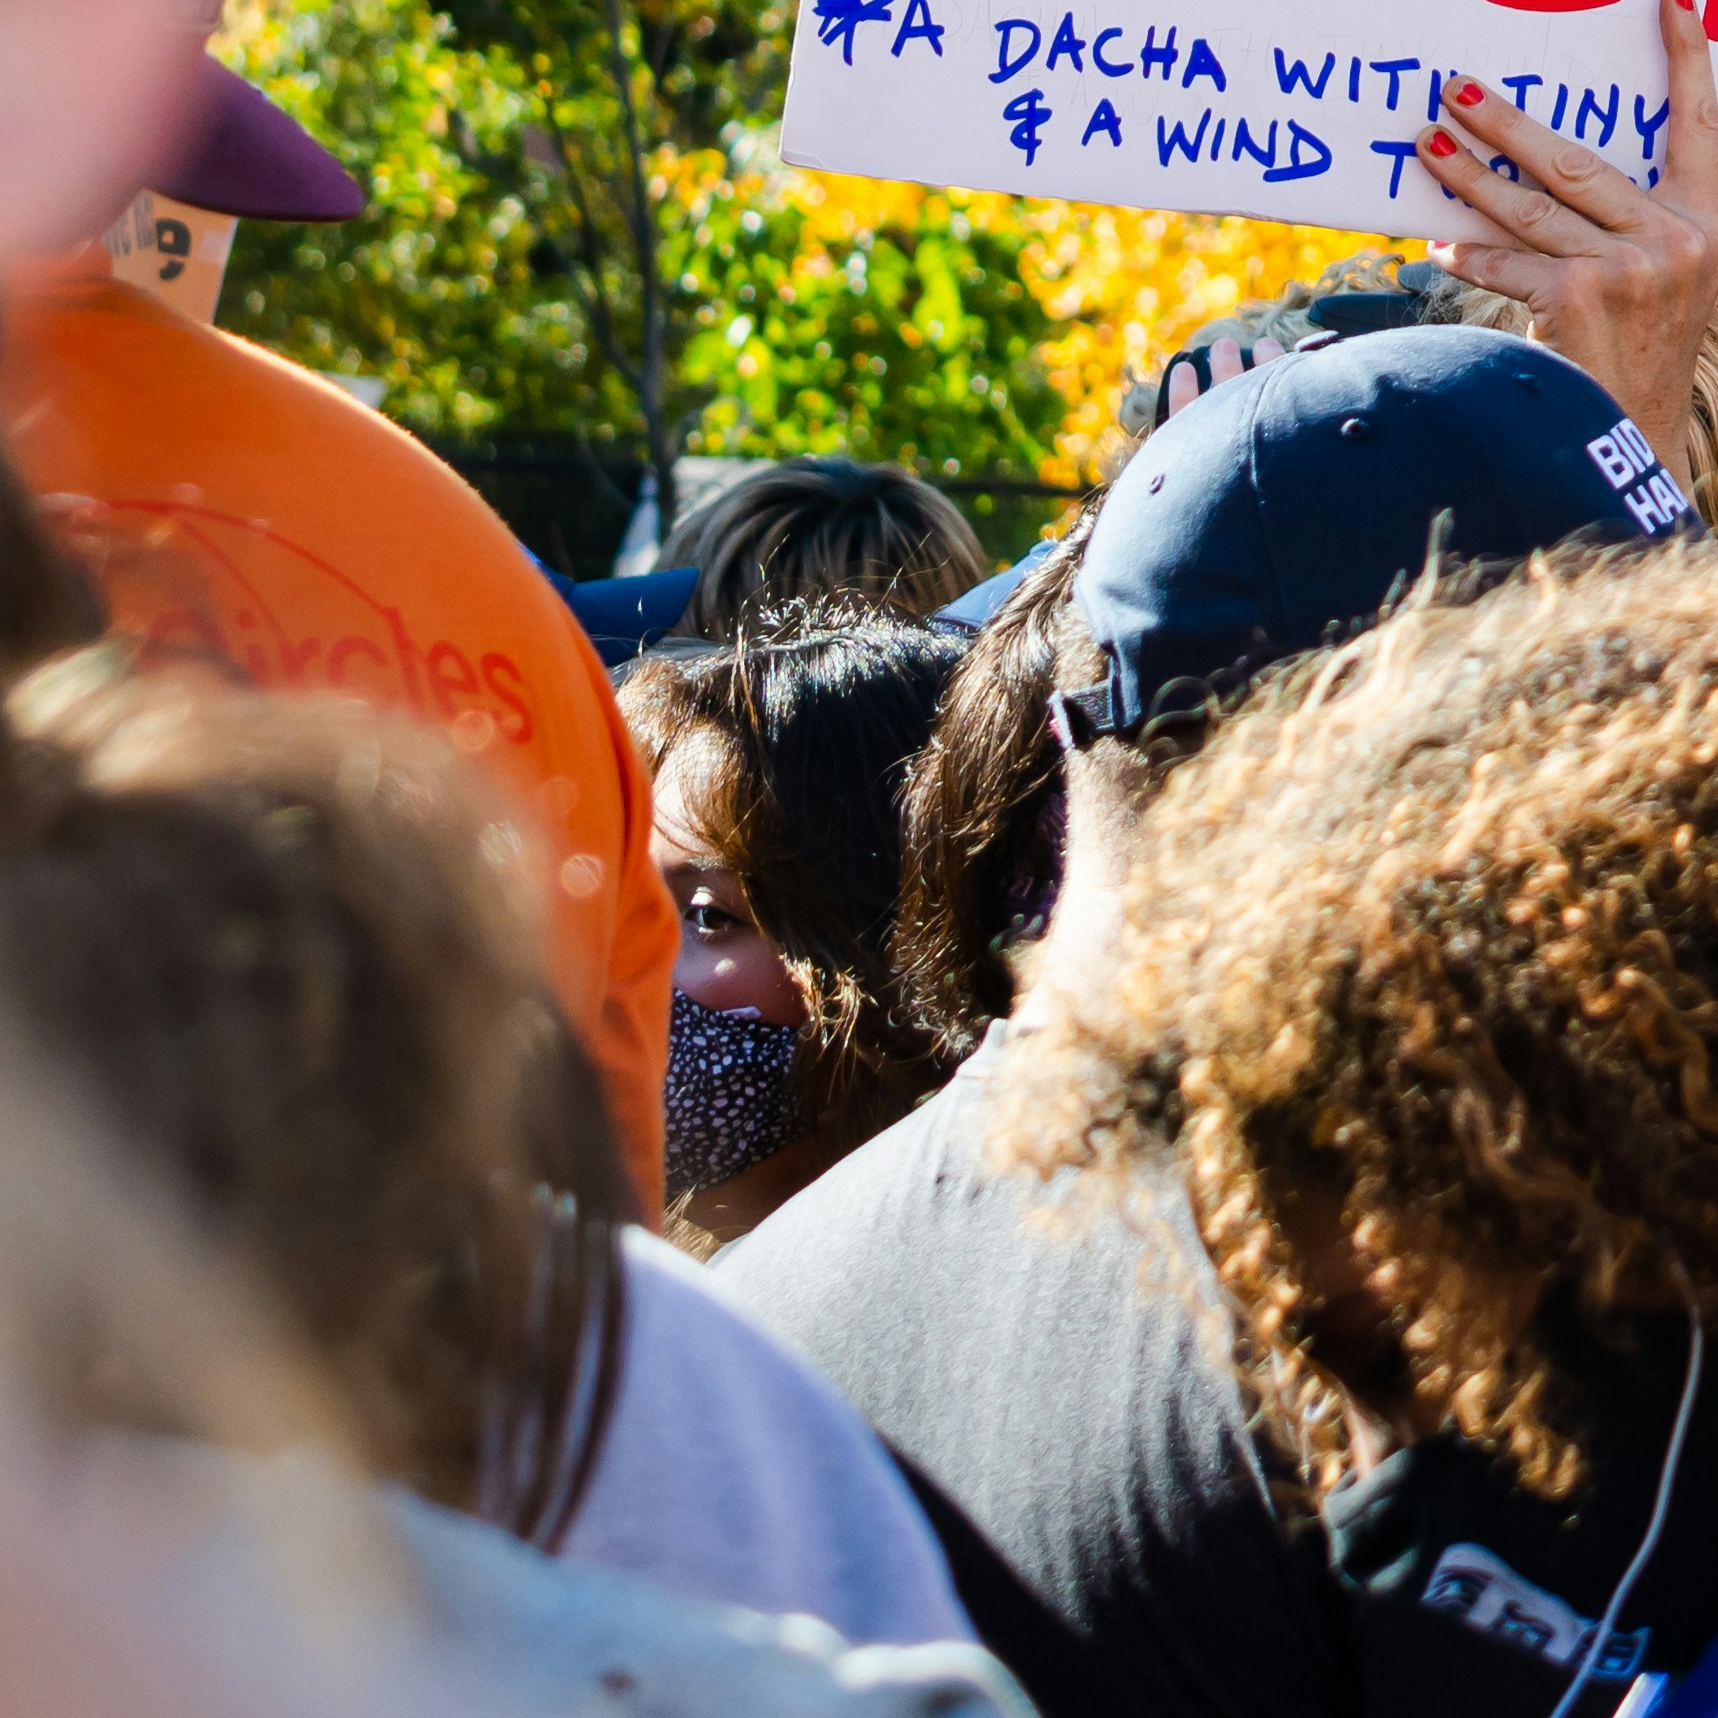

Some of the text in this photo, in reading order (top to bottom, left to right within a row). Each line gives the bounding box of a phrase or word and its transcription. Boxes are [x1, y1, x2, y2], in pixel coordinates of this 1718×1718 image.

[989, 11, 1226, 92] DACHA
[1502, 75, 1669, 160] TINY
[1003, 89, 1052, 167] &
[1082, 99, 1122, 148] A
[1157, 109, 1332, 183] WIND
